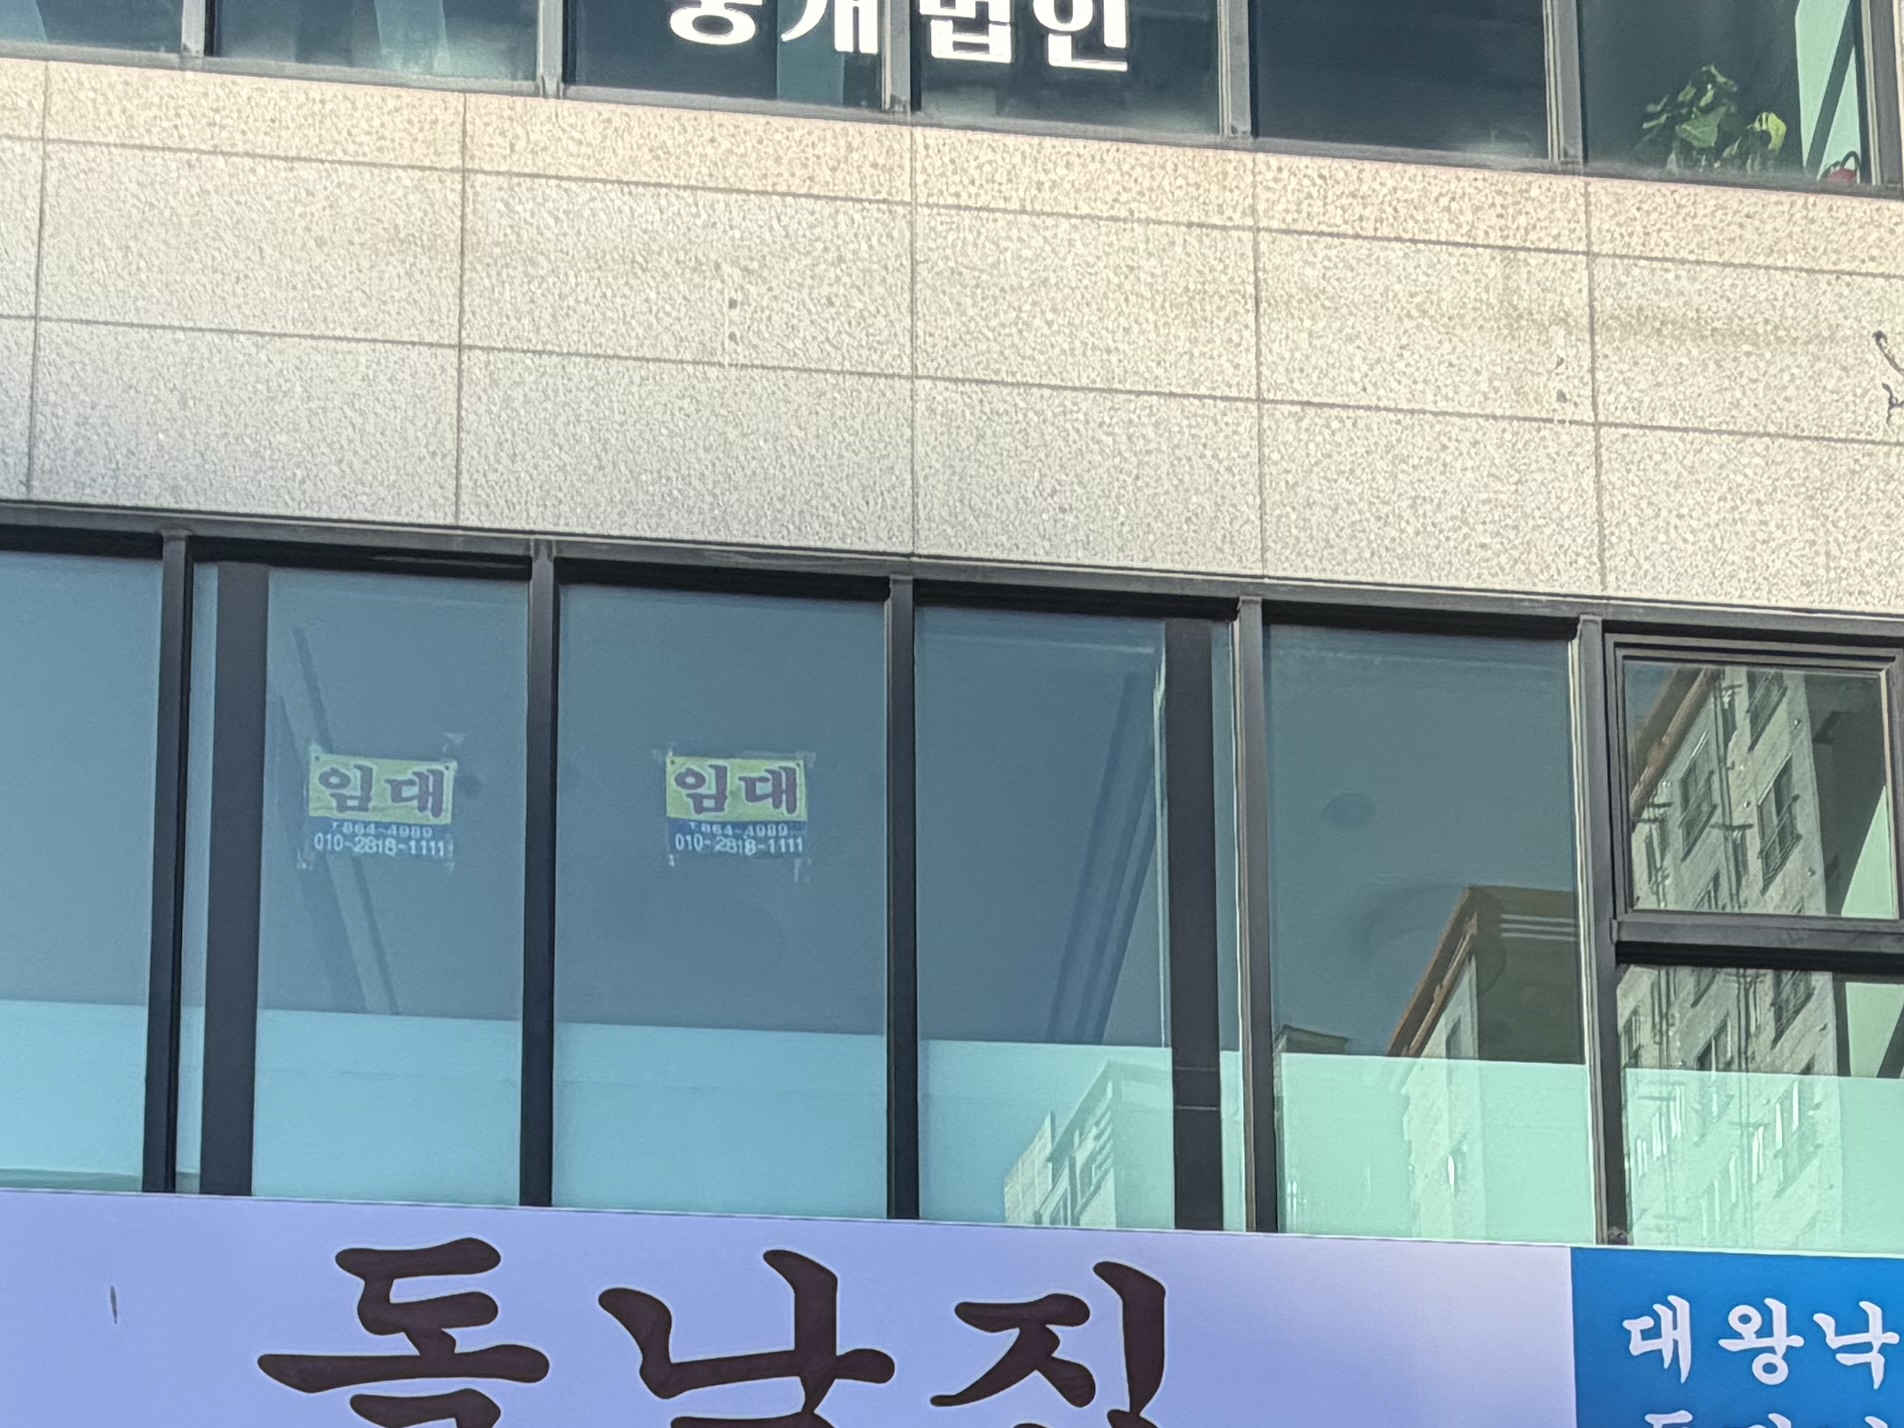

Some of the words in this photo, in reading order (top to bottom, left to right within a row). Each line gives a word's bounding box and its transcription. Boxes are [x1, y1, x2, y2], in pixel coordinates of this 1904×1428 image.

[318, 764, 444, 819] 임대
[674, 764, 797, 816] 임대
[314, 833, 445, 857] 010-2818-1111
[675, 833, 803, 856] 010-2818-1111
